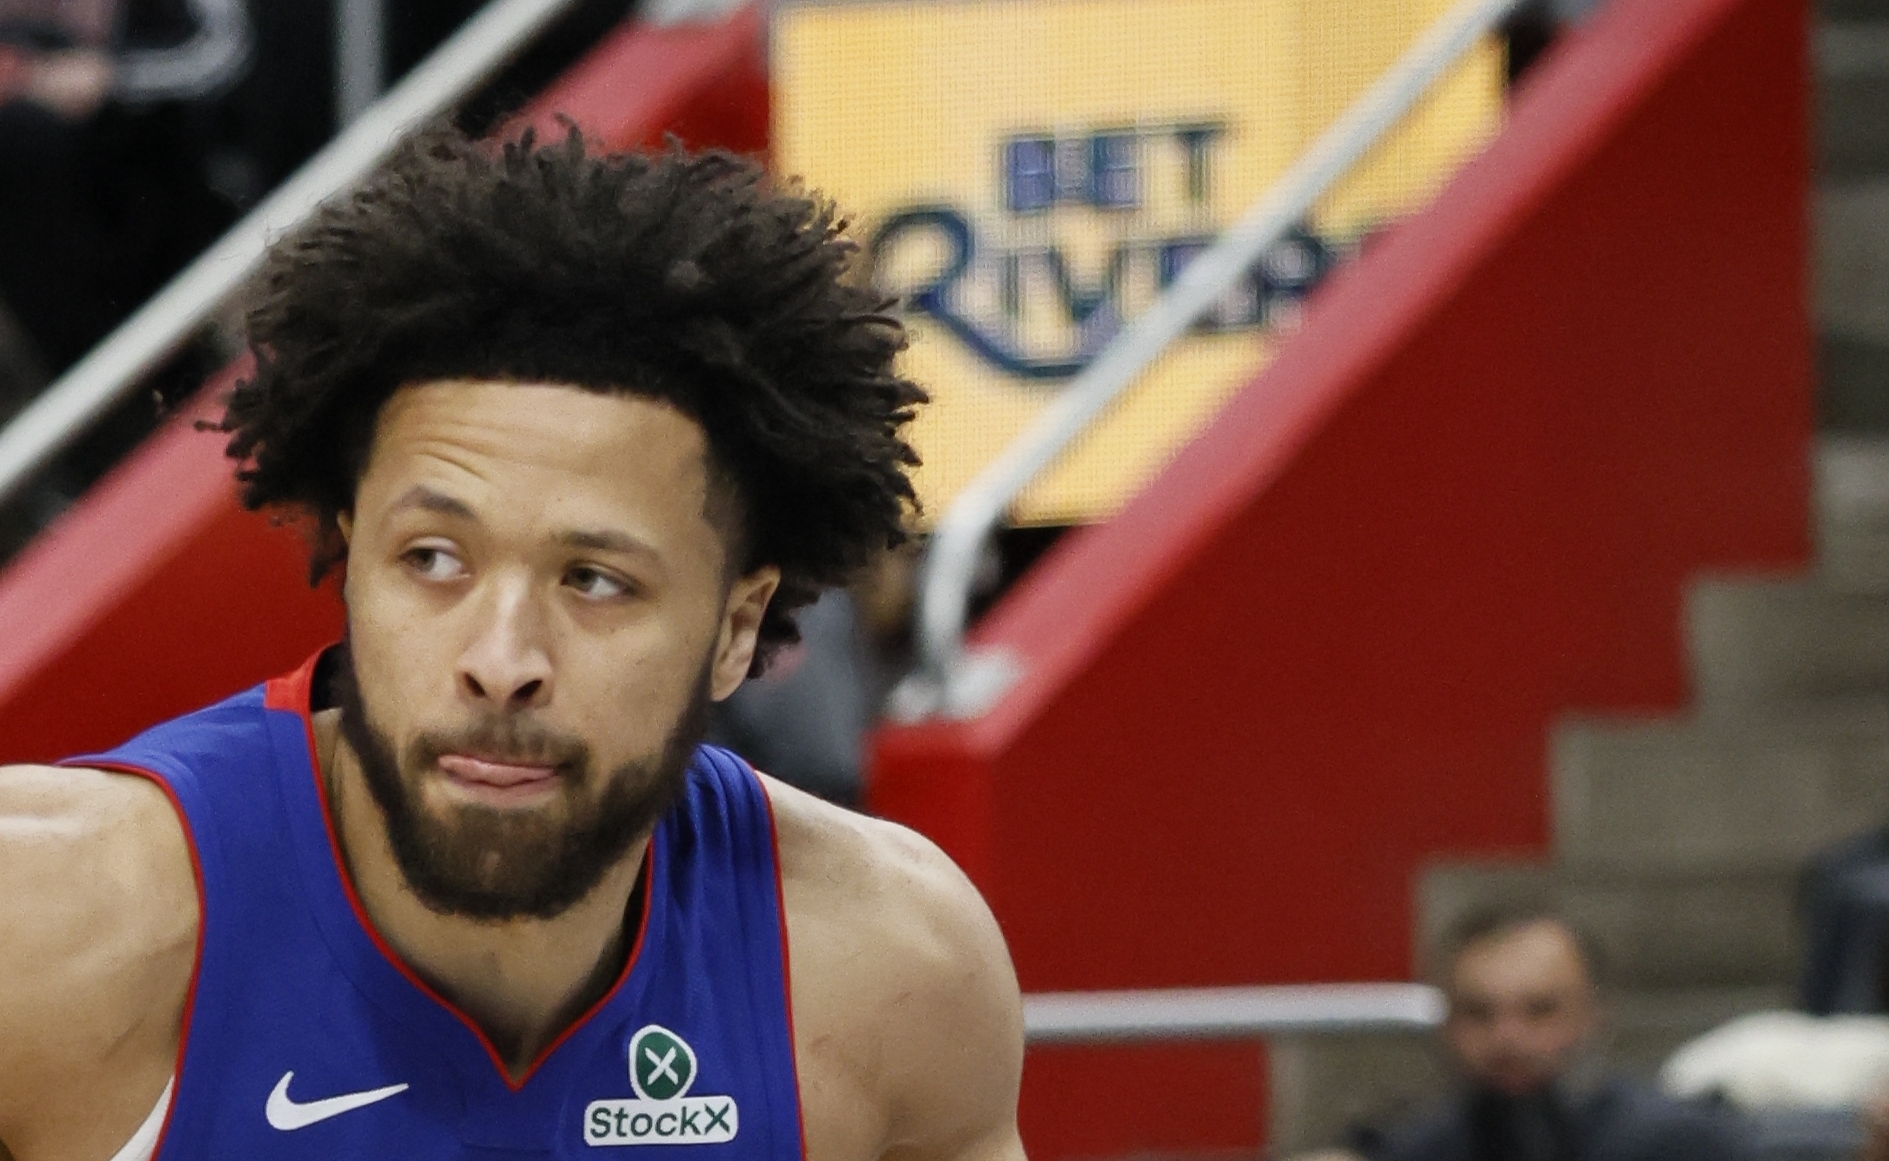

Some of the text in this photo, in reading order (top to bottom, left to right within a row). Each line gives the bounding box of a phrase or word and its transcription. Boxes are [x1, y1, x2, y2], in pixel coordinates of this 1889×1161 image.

[999, 114, 1228, 214] BET
[868, 205, 1336, 378] RIVER
[589, 1104, 732, 1138] StockX
